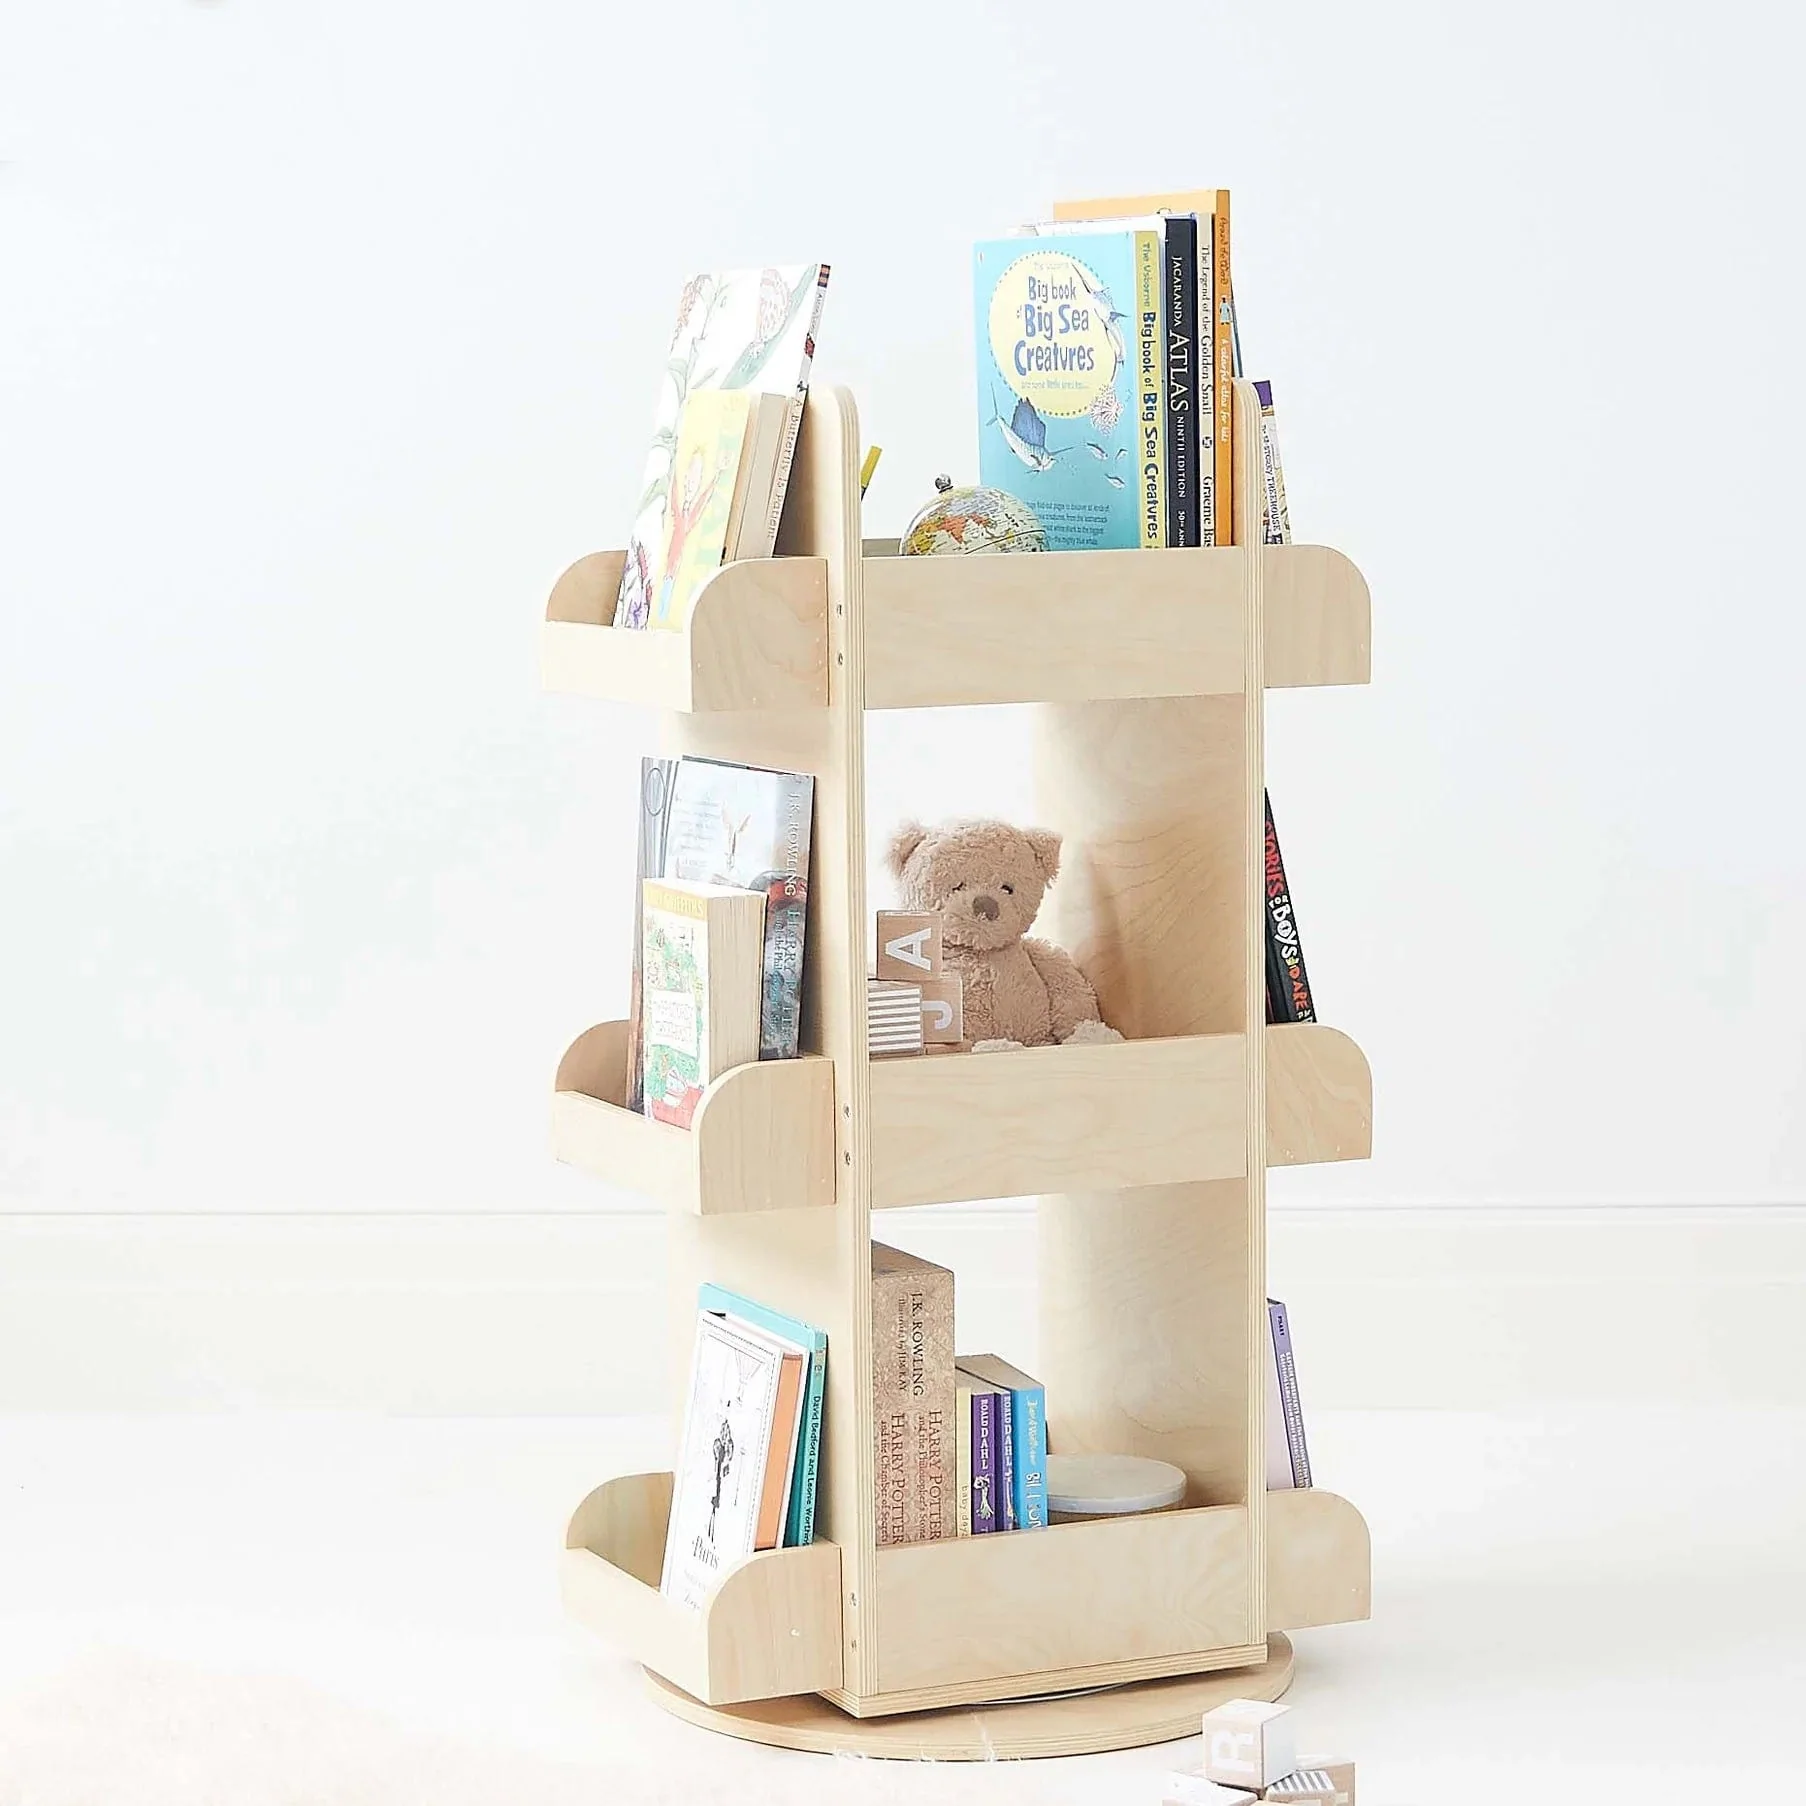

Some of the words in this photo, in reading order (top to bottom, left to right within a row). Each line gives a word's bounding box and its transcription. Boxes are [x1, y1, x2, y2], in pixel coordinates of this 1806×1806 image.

[1142, 242, 1151, 262] The
[1201, 245, 1210, 265] The
[1028, 276, 1048, 303] Big
[1051, 274, 1076, 300] book
[1142, 264, 1151, 307] Usborne
[1171, 255, 1183, 327] JACARANDA
[1199, 266, 1211, 301] Legend
[1024, 304, 1053, 340] Big
[1058, 304, 1089, 334] Sea
[1140, 311, 1156, 338] Big
[1202, 303, 1211, 313] of
[1202, 316, 1211, 332] the
[1014, 340, 1094, 376] Creatures
[1142, 340, 1156, 374] book
[1169, 329, 1190, 412] ATLAS
[1201, 335, 1212, 380] Golden
[1144, 377, 1154, 388] of
[1202, 383, 1212, 415] Snail
[1142, 392, 1157, 421] Big
[781, 414, 800, 473] Butterfly
[1144, 427, 1157, 458] Sea
[1176, 416, 1185, 451] NINTH
[1177, 455, 1186, 498] EDITION
[1144, 463, 1159, 539] Creatures
[1203, 476, 1213, 525] Graeme
[1266, 476, 1281, 533] TREEHOUSE
[784, 822, 799, 896] ROWLING
[784, 910, 800, 975] HARRY
[885, 927, 932, 971] A
[1268, 894, 1289, 909] FOR
[1288, 966, 1308, 1010] DARE
[780, 979, 796, 1045] POTTER
[920, 1000, 953, 1031] J
[911, 1292, 923, 1317] J.K.
[912, 1321, 924, 1396] ROWLING
[898, 1371, 907, 1392] KAY
[811, 1396, 821, 1420] David
[919, 1416, 928, 1432] and
[980, 1399, 989, 1426] ROALD
[809, 1421, 819, 1456] Bedford
[881, 1420, 889, 1436] and
[881, 1438, 889, 1453] the
[891, 1413, 905, 1474] HARRY
[919, 1433, 928, 1449] the
[929, 1409, 942, 1470] HARRY
[1004, 1424, 1012, 1467] DAHL
[980, 1427, 989, 1470] DAHL
[807, 1457, 816, 1476] and
[881, 1455, 890, 1497] Chamber
[806, 1477, 815, 1506] Leonie
[881, 1498, 890, 1509] of
[929, 1473, 943, 1541] POTTER
[959, 1485, 968, 1510] baby
[881, 1511, 889, 1543] Secrets
[891, 1478, 905, 1545] POTTER
[919, 1514, 928, 1539] Stone
[1211, 1731, 1255, 1773] R
